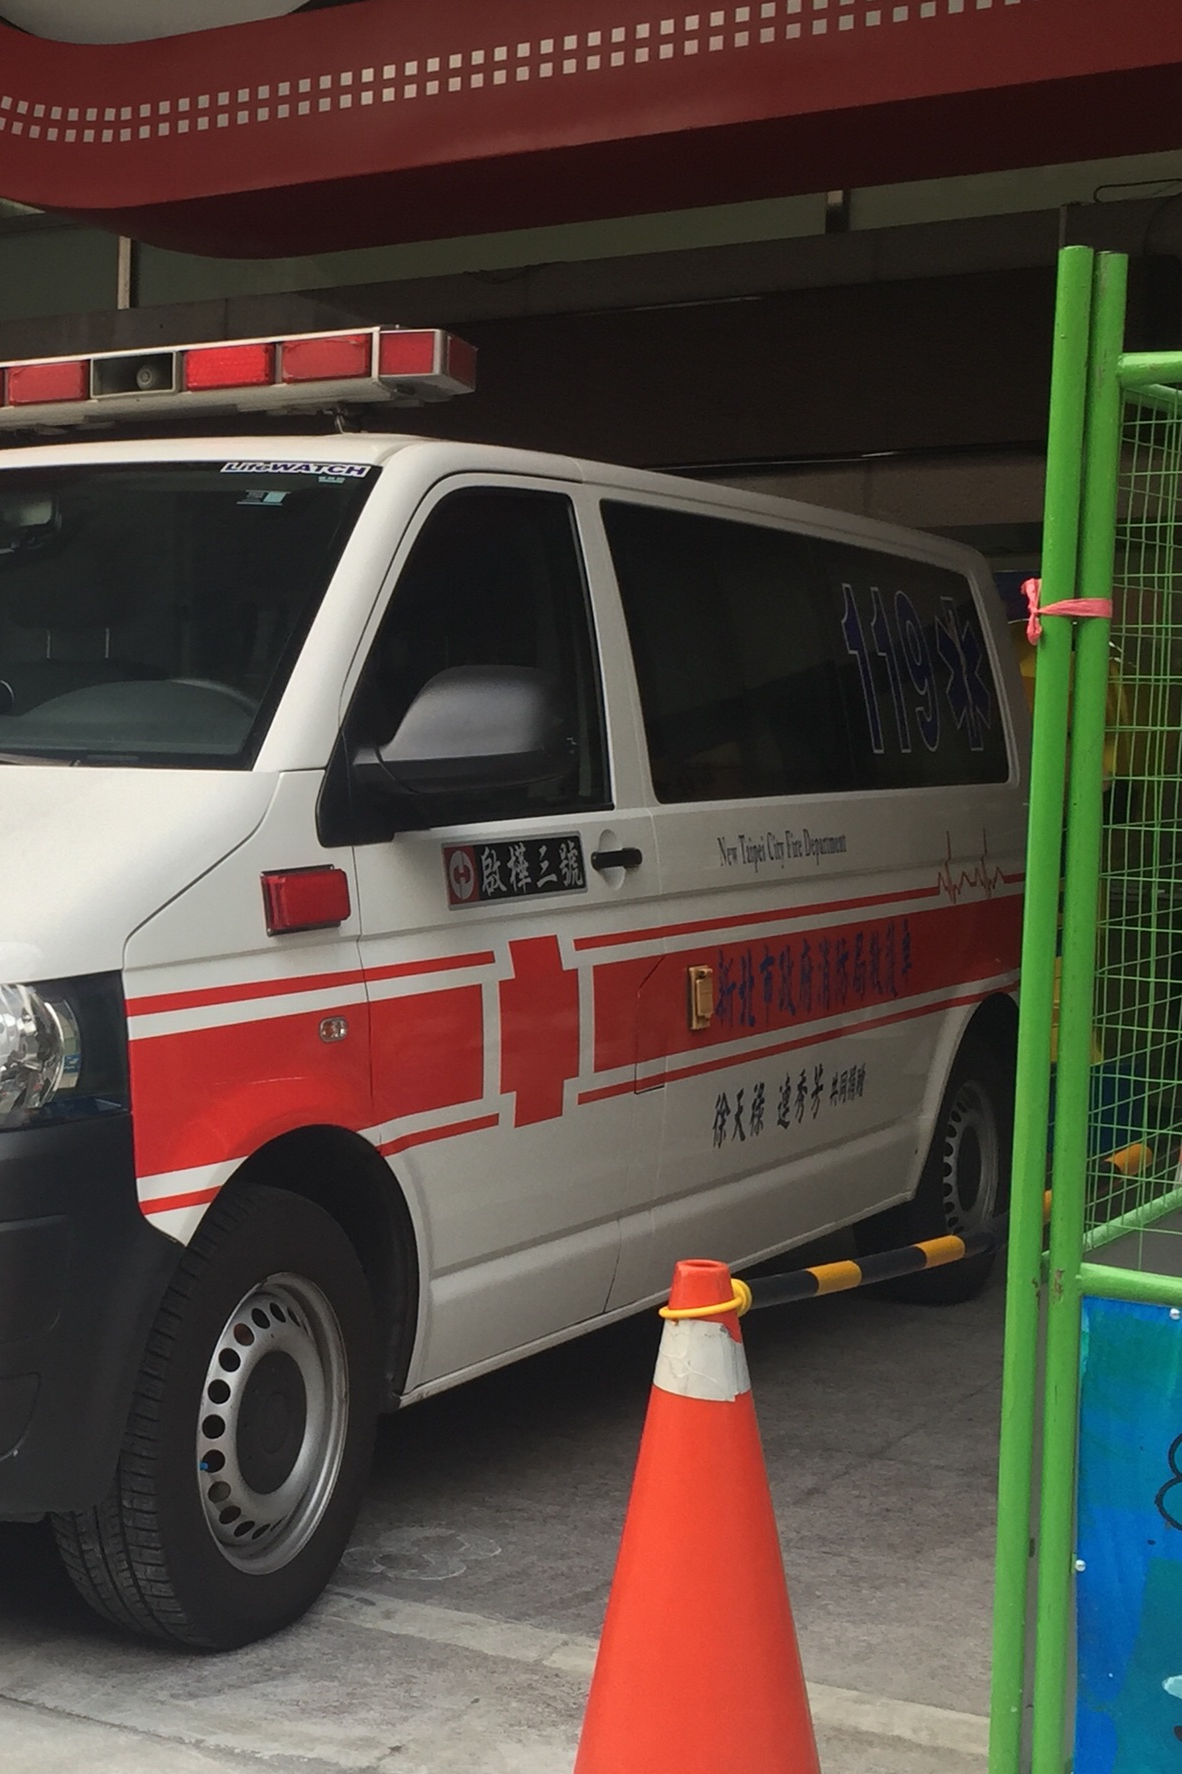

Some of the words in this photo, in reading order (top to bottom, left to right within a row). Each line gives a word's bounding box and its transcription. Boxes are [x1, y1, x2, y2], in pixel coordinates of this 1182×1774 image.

[221, 461, 369, 477] LifeWATCH
[841, 582, 940, 754] 119
[717, 837, 737, 866] New
[738, 834, 766, 873] Taipei
[766, 832, 784, 869] City
[785, 830, 802, 858] Fire
[803, 828, 847, 866] Department
